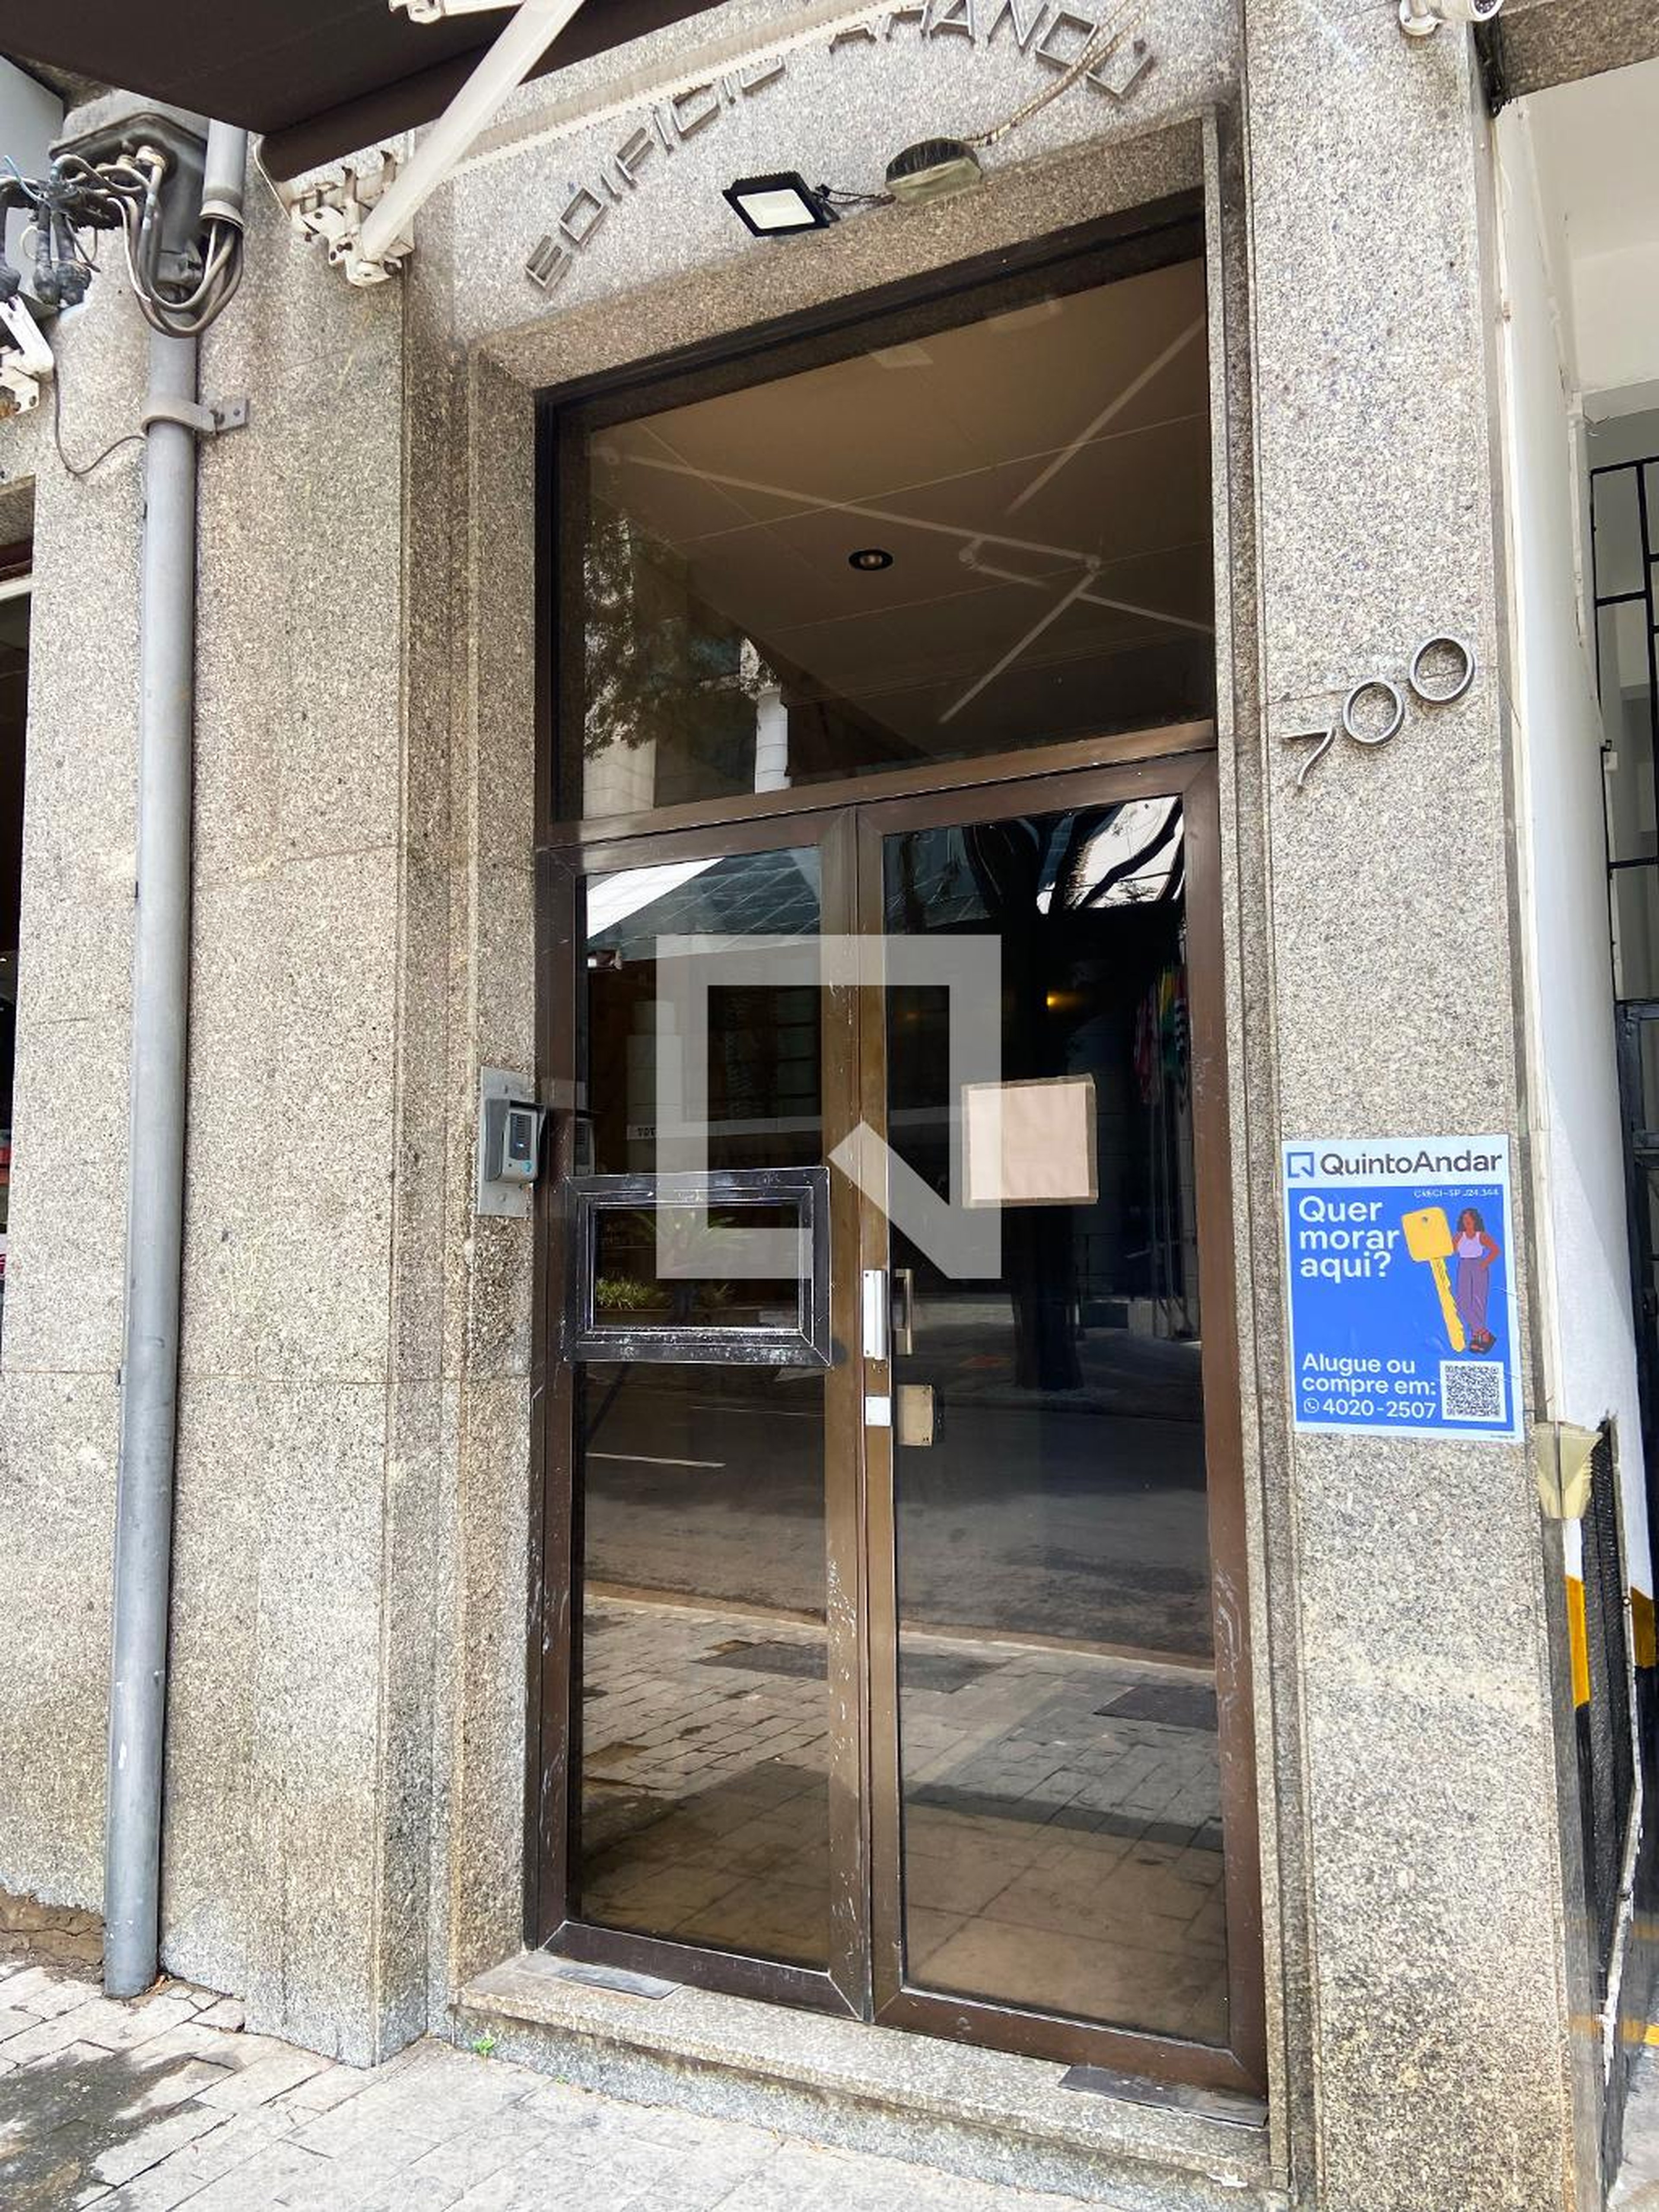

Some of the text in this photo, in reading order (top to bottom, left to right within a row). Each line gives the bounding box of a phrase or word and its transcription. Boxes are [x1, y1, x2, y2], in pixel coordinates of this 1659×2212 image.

[1281, 634, 1475, 788] 700
[1320, 1150, 1502, 1176] QuintoAndar
[1299, 1195, 1382, 1222] Quer
[1300, 1230, 1400, 1250] morar
[1300, 1251, 1391, 1284] aqui?
[1302, 1353, 1415, 1376] Alugue ou
[1302, 1377, 1436, 1397] compre em:
